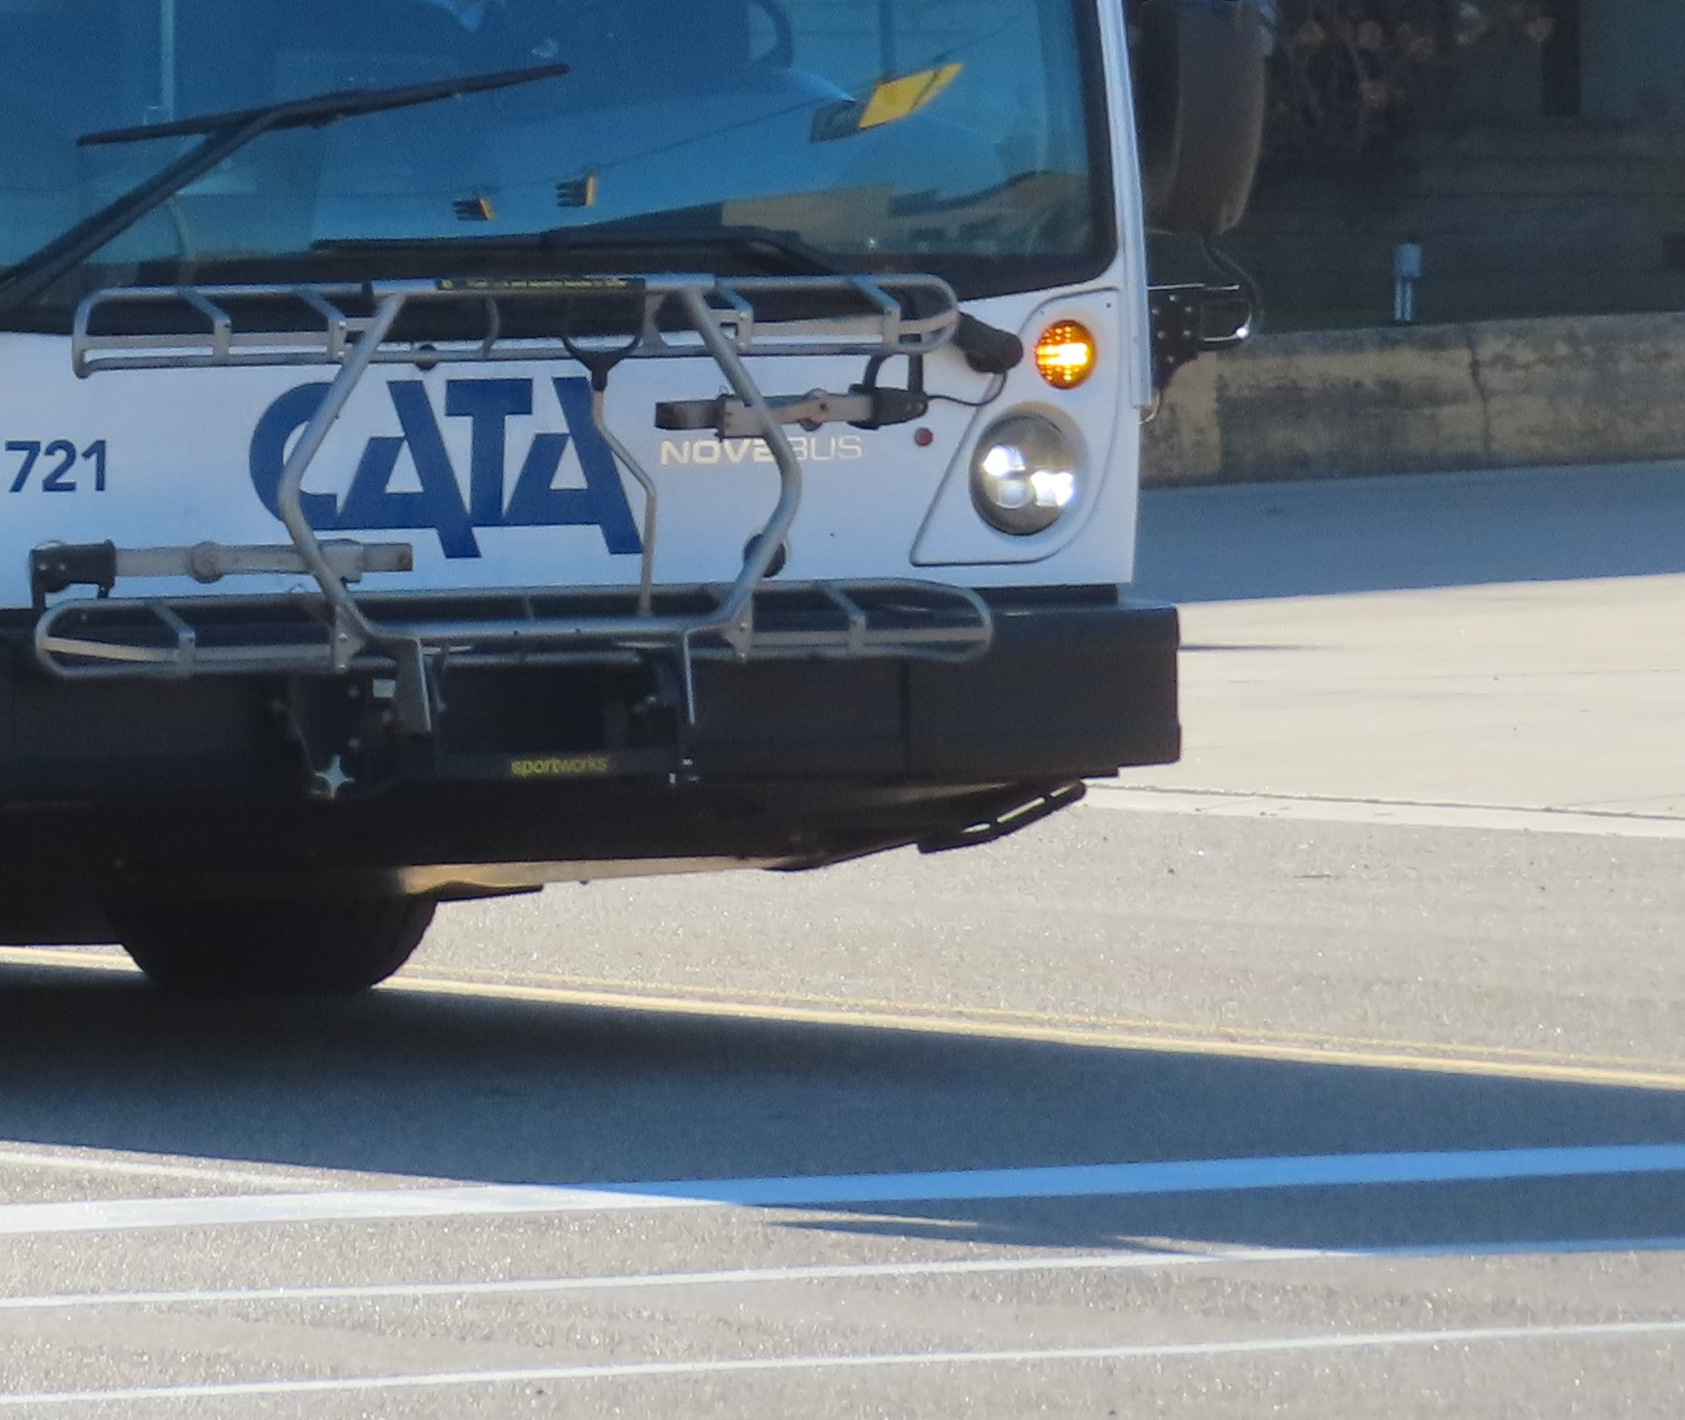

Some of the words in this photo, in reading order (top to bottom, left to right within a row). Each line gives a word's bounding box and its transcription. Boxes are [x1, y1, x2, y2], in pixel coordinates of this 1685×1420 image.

[4, 439, 108, 493] 721
[248, 376, 644, 559] CATA
[510, 755, 609, 778] sportworks
